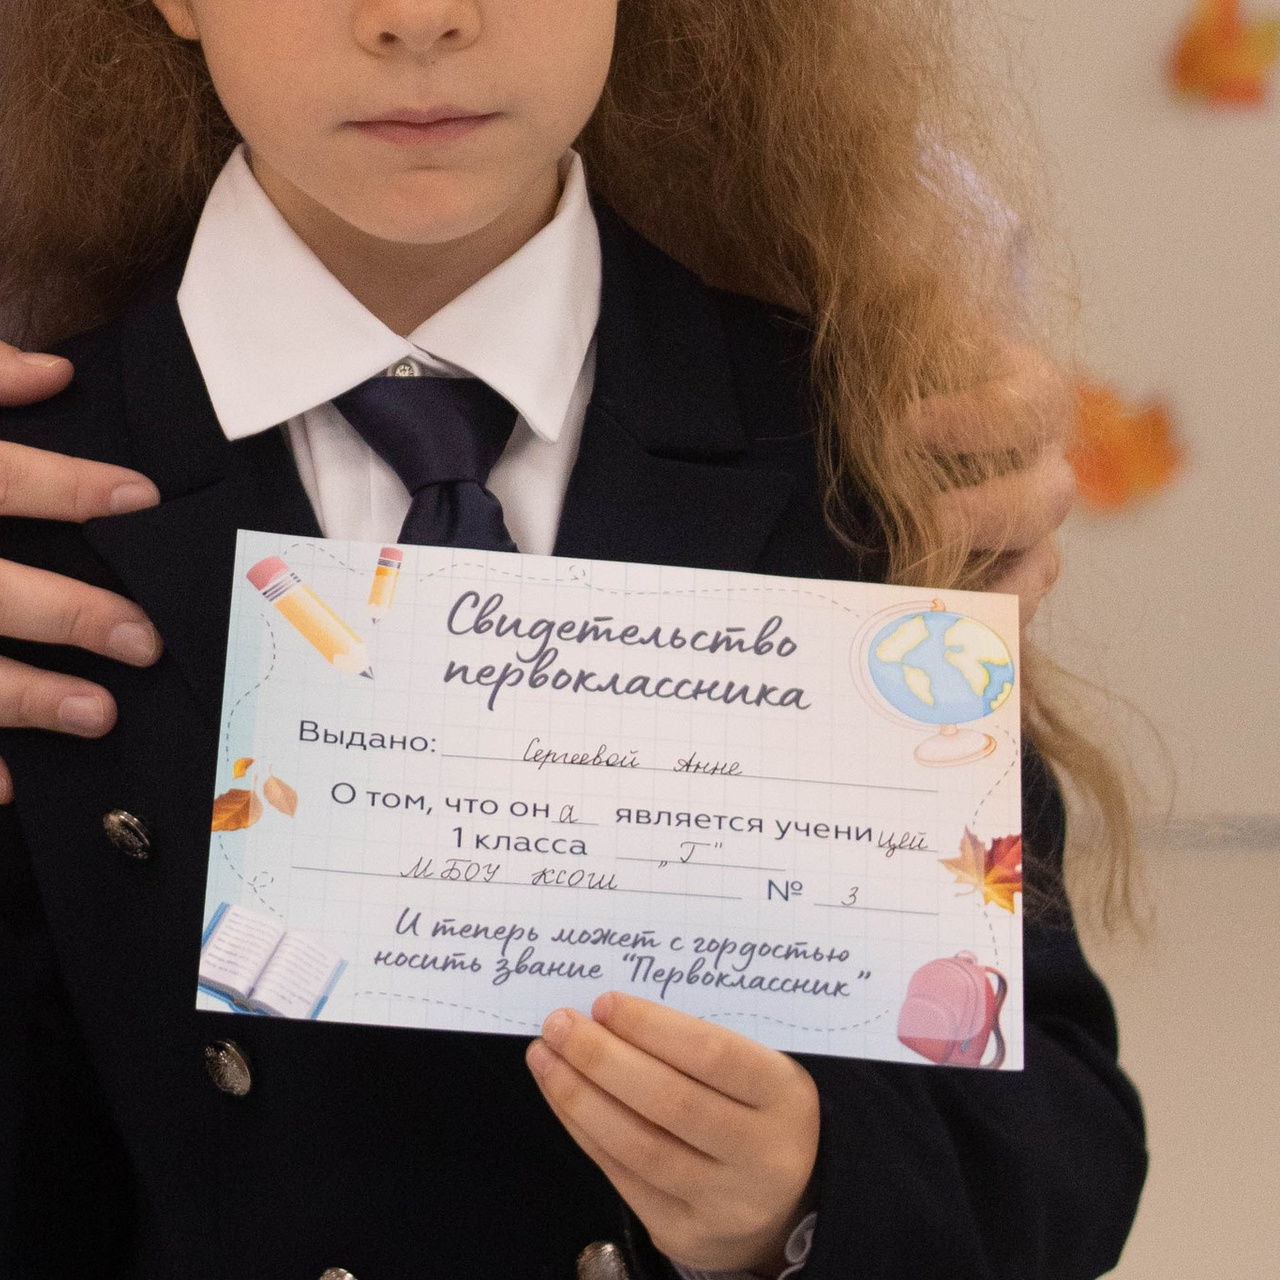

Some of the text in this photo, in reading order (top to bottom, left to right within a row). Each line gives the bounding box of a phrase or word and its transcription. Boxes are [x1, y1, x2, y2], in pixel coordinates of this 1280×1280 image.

[446, 590, 797, 663] Свидетельство
[444, 648, 811, 711] первоклассника
[299, 720, 743, 775] Выдано: Сергеевой Анне
[331, 782, 356, 804] О
[366, 791, 433, 815] том,
[445, 797, 499, 815] что
[615, 806, 764, 834] является
[452, 826, 463, 848] 1
[475, 833, 588, 856] класса
[767, 879, 804, 902] №
[841, 886, 859, 907] 3
[395, 906, 851, 971] И теперь может с гордостью
[374, 950, 482, 973] носить
[492, 946, 604, 986] звание
